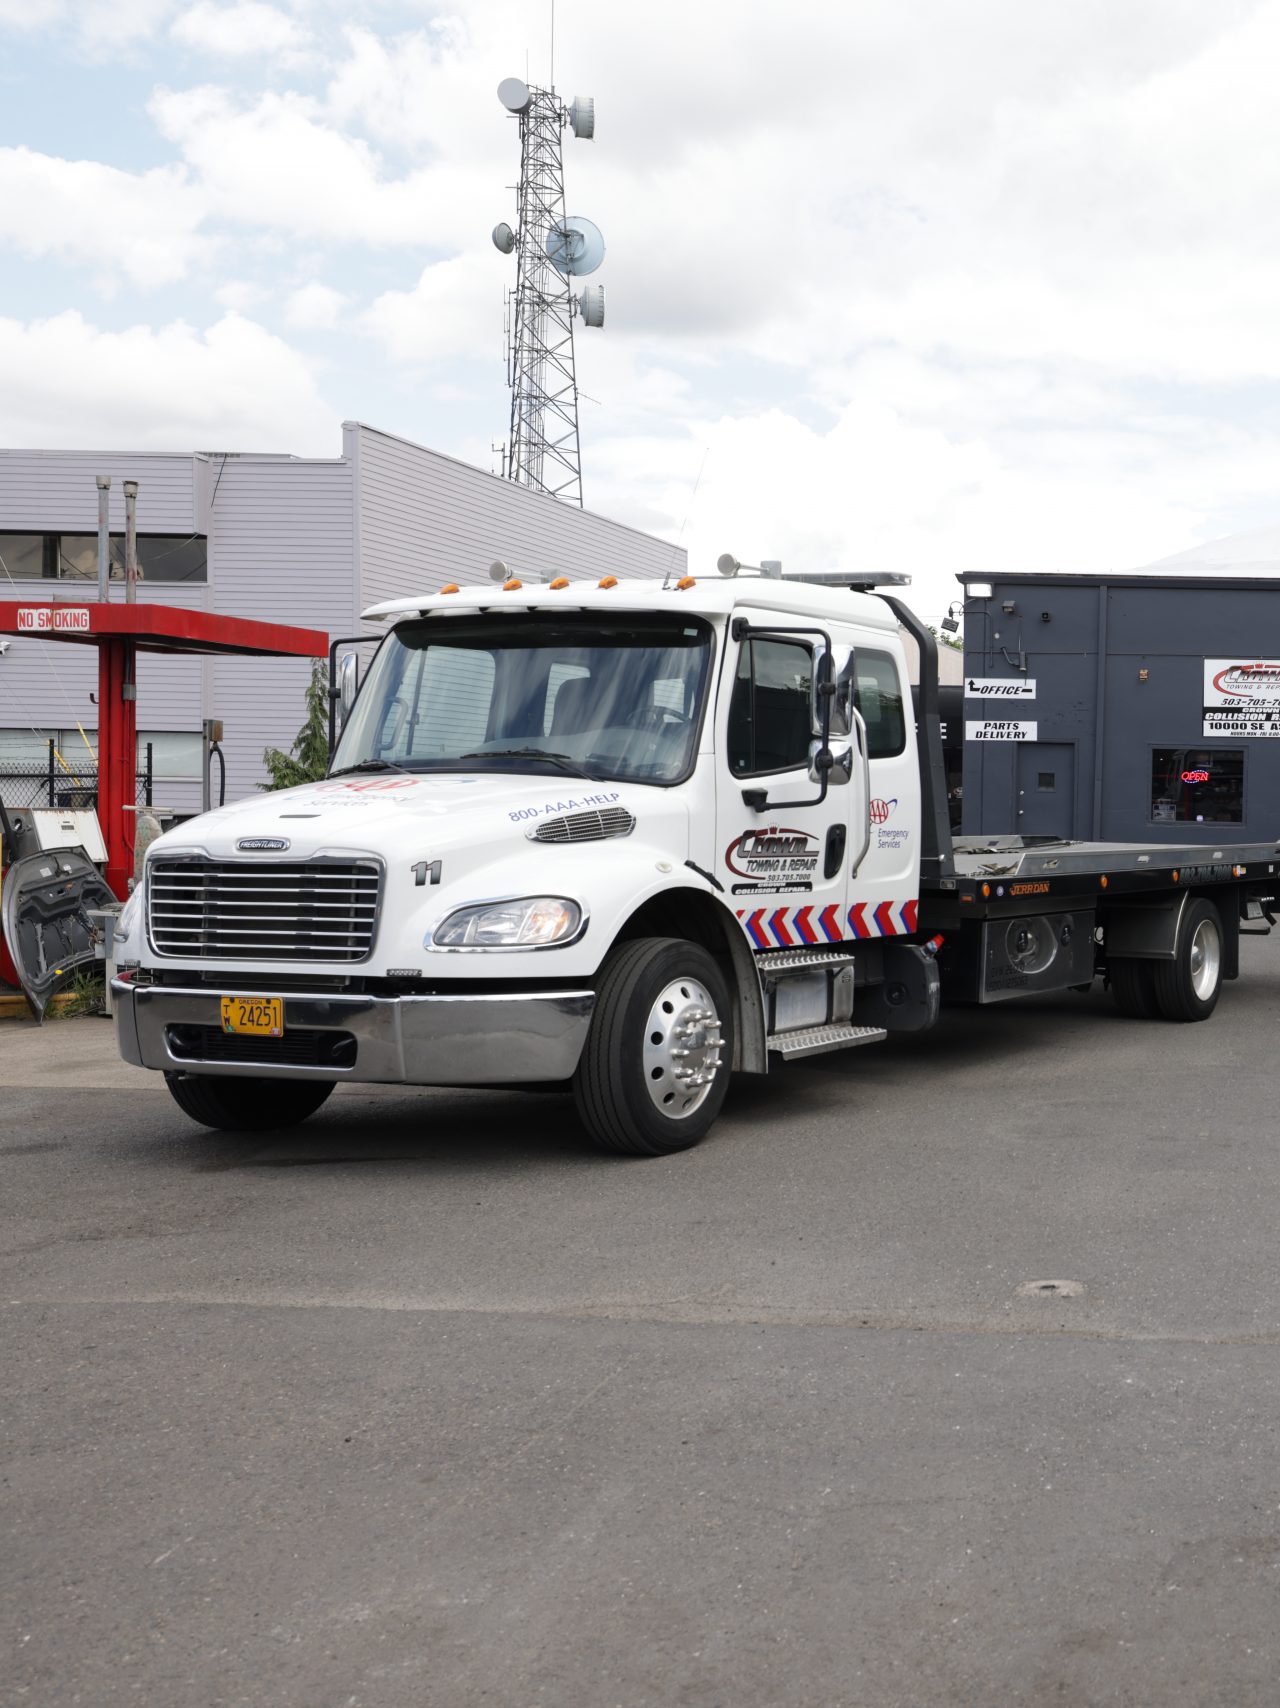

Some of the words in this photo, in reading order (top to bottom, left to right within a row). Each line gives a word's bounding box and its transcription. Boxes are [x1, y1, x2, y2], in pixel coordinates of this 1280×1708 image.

[18, 612, 33, 628] NO
[38, 612, 88, 628] SMOKING
[980, 685, 1022, 695] OFFICE
[1205, 712, 1267, 721] COLLISION
[984, 722, 1019, 730] PARTS
[1208, 722, 1248, 730] 10000
[1251, 722, 1265, 730] SE
[975, 731, 1028, 739] DELIVERY
[1181, 771, 1209, 781] OPEN
[508, 792, 620, 822] 800-AAA-HELP
[878, 828, 909, 840] Emergency
[878, 839, 901, 848] Services
[746, 860, 780, 873] TOWING
[780, 860, 787, 871] &
[788, 859, 818, 871] REPAIR
[411, 860, 442, 886] 11
[767, 873, 811, 881] 503.705.7000
[735, 887, 776, 895] COLLISION
[239, 1005, 277, 1026] 24251
